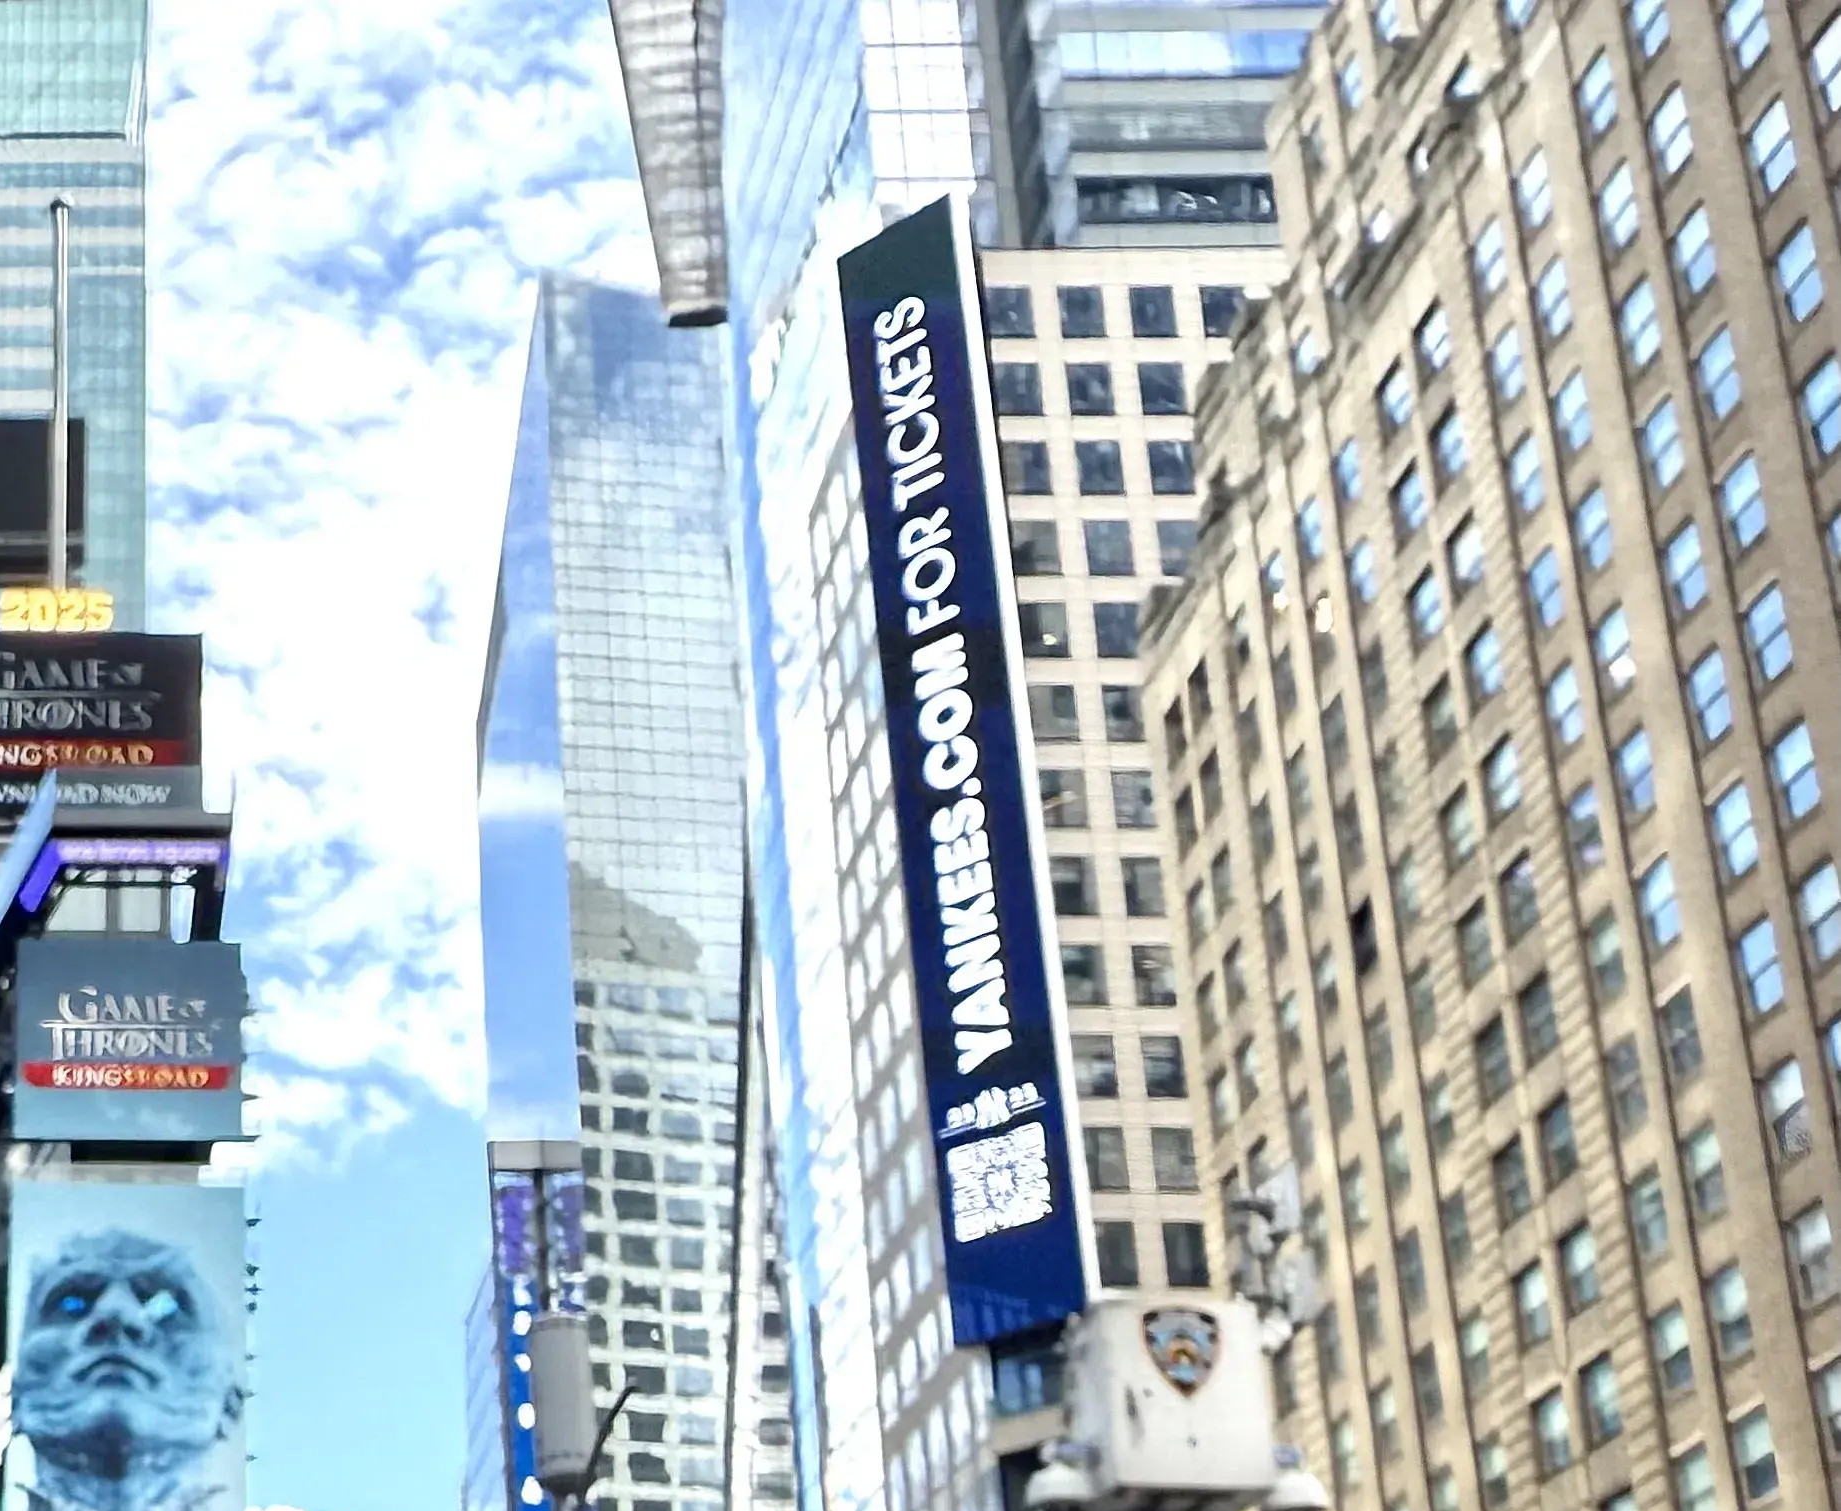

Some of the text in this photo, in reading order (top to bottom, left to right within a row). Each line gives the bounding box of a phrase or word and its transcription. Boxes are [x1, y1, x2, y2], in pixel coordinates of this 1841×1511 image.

[874, 296, 1013, 1076] YANKEES.COM FOR TICKETS
[58, 985, 176, 1024] GAME
